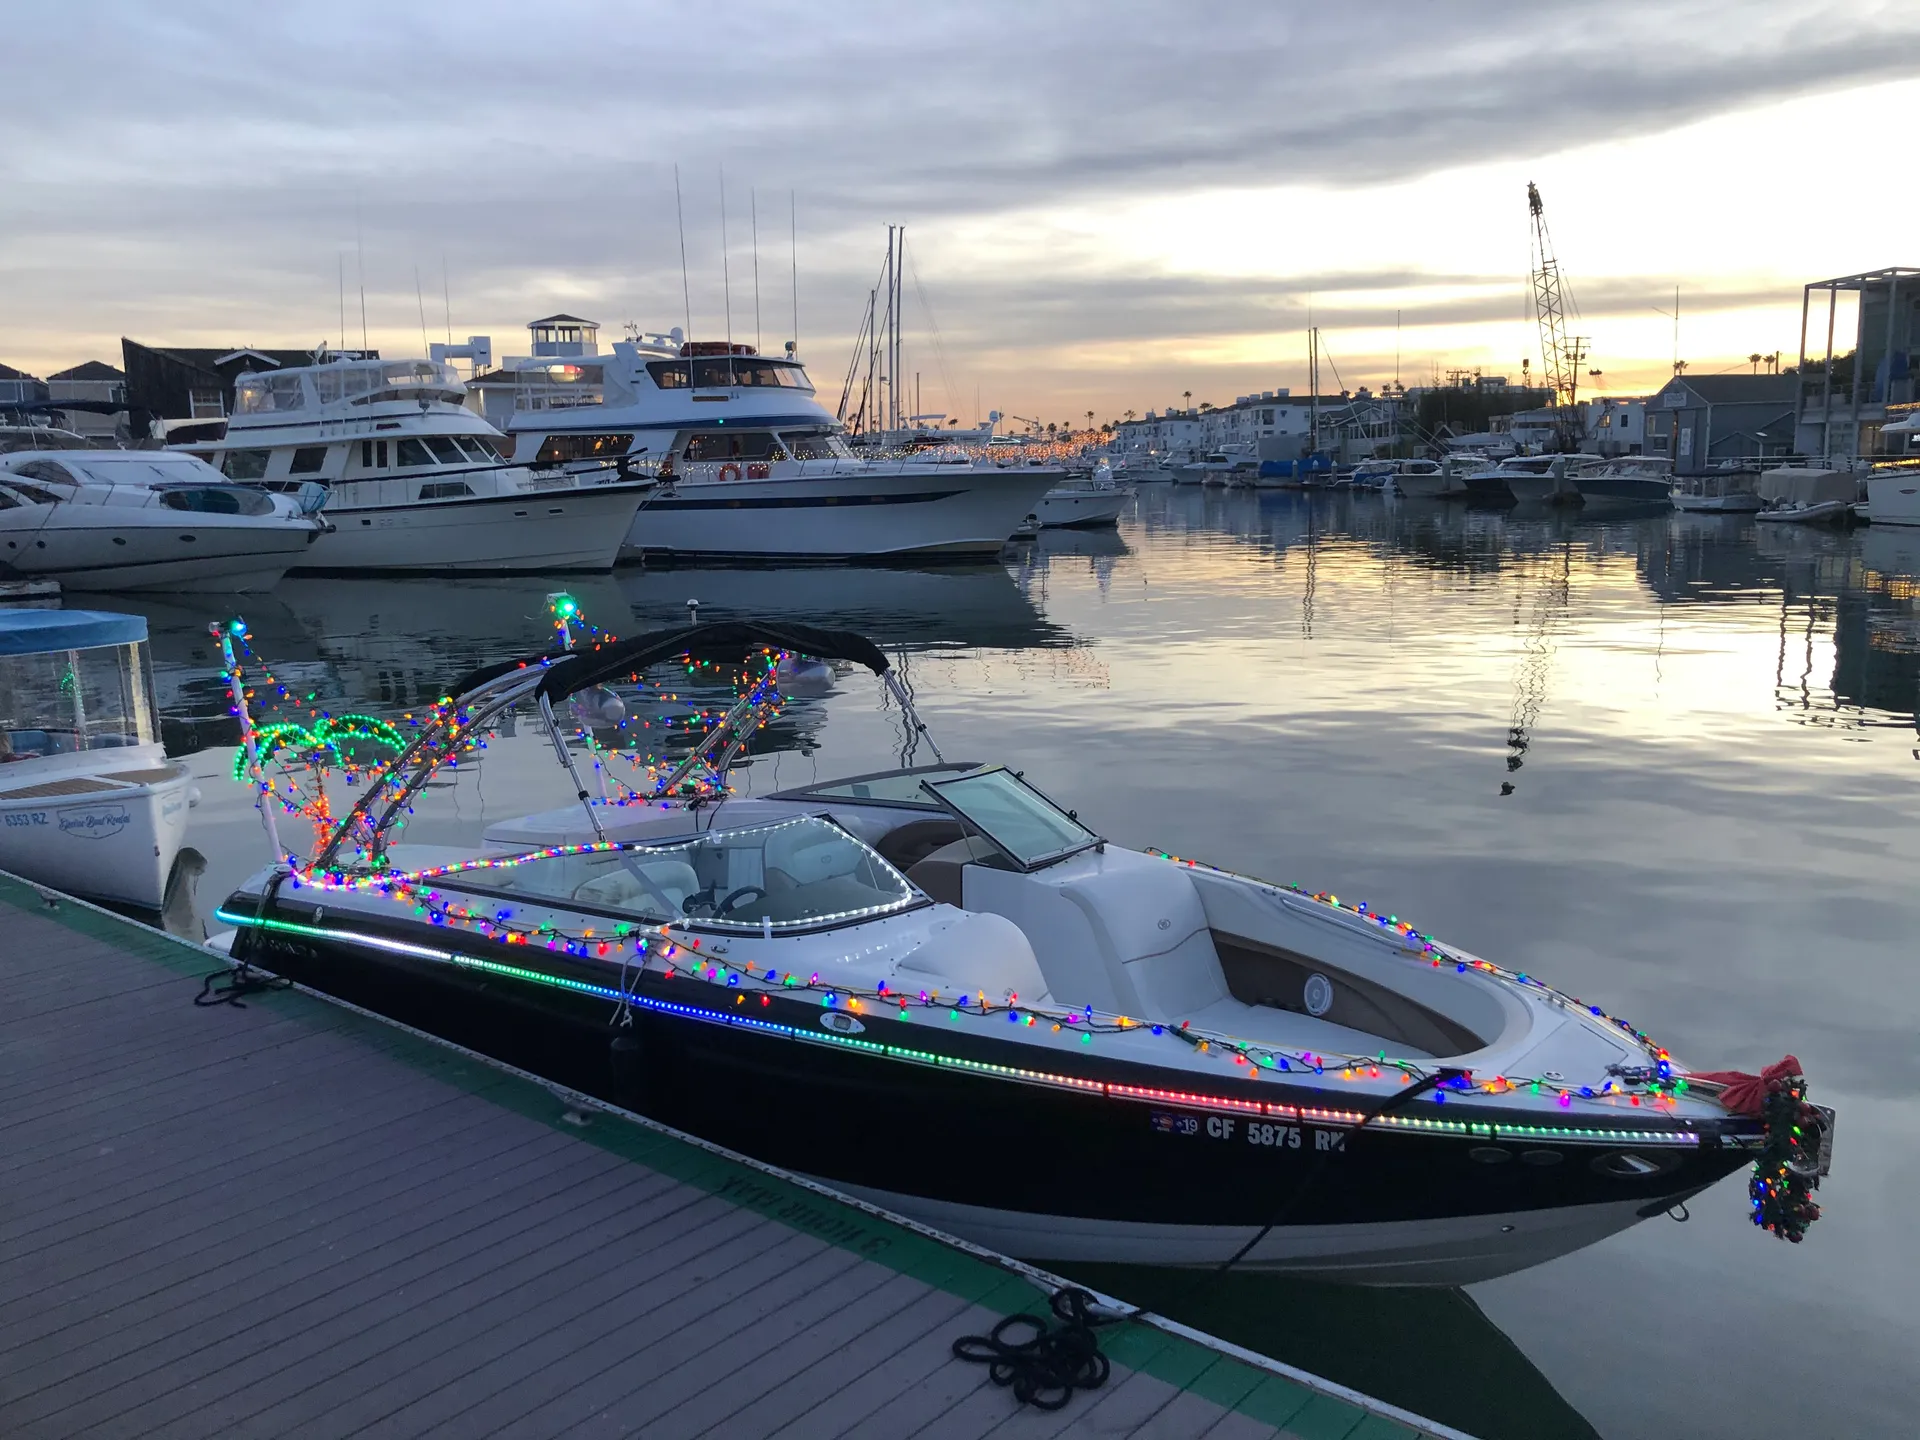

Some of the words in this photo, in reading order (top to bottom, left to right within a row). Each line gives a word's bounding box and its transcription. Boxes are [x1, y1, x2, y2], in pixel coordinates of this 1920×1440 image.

[5, 814, 30, 828] 6353
[31, 812, 49, 826] RZ
[1182, 1118, 1198, 1133] 19
[1206, 1116, 1236, 1140] CF
[1247, 1122, 1302, 1149] 5875
